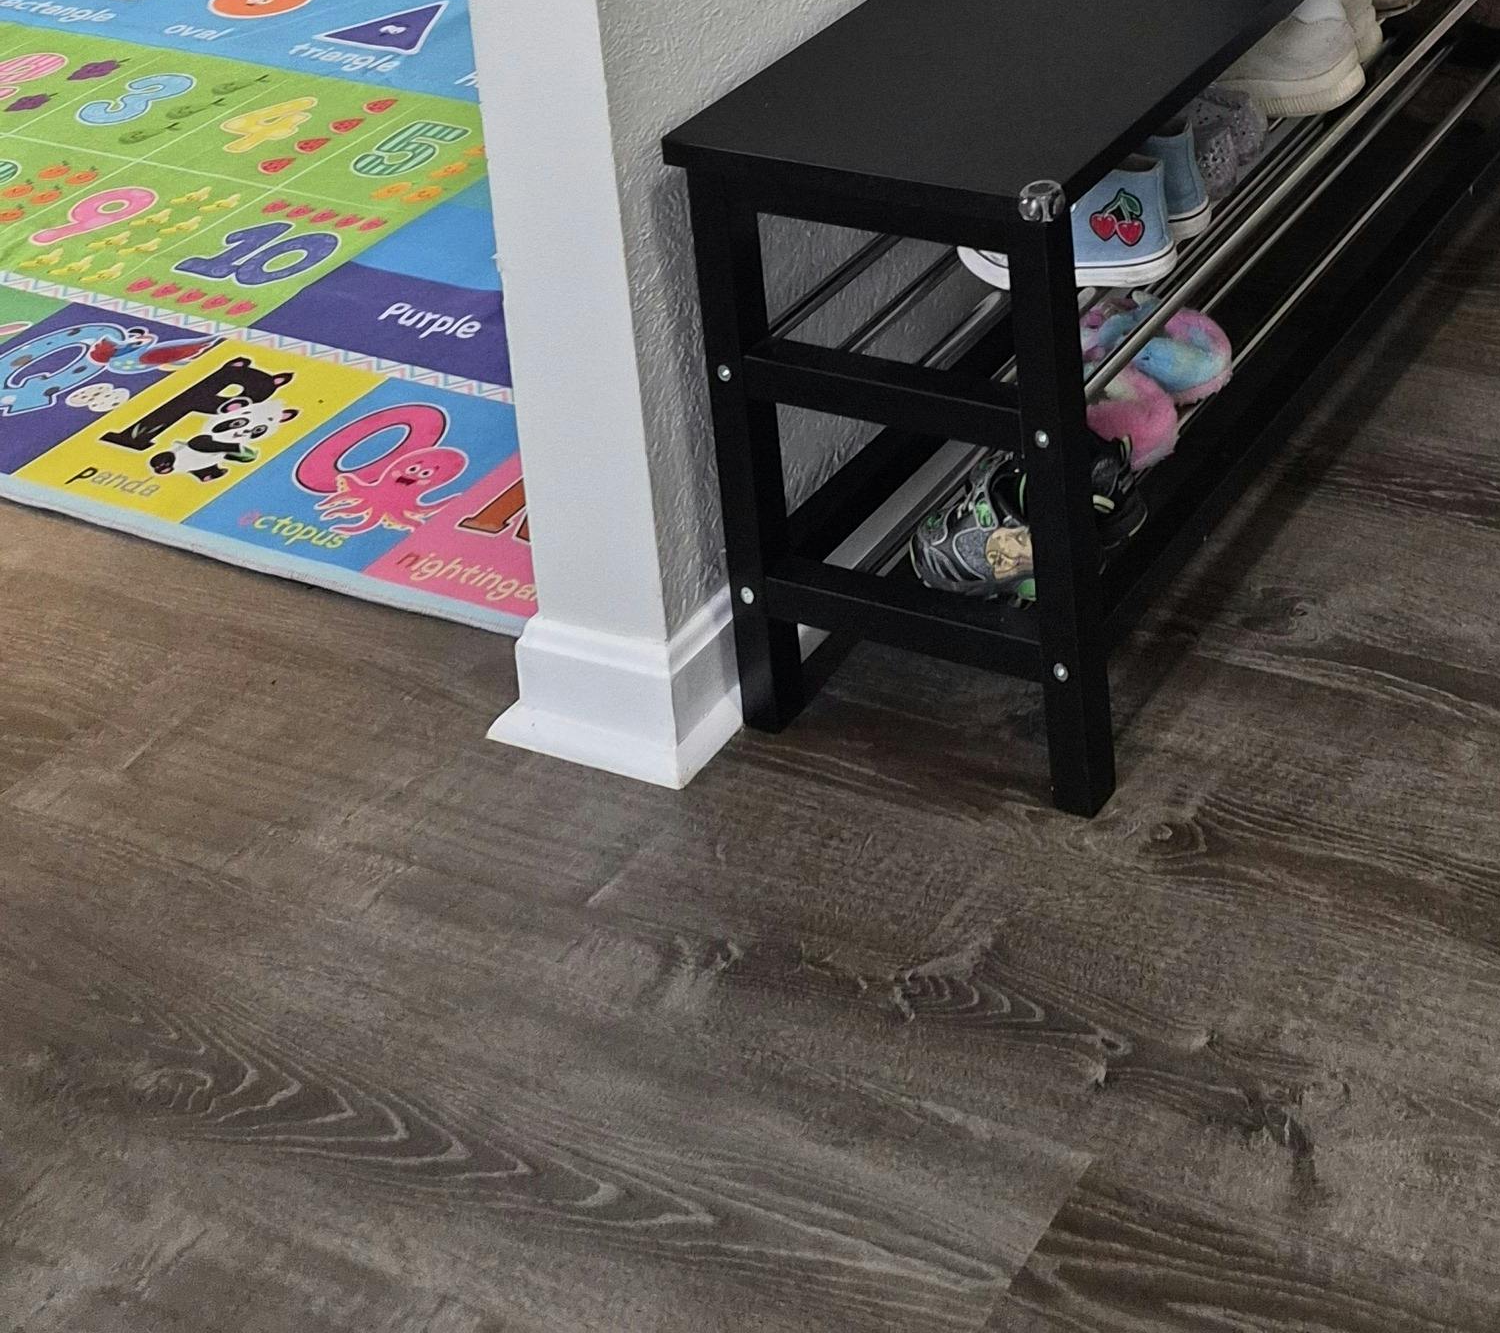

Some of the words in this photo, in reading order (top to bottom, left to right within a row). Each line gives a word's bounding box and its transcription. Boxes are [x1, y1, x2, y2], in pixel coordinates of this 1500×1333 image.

[163, 22, 231, 43] oval
[287, 43, 399, 74] triangle
[75, 72, 198, 126] 3
[220, 96, 318, 154] 4
[350, 119, 471, 178] 5
[29, 186, 160, 247] 9
[171, 220, 342, 288] 10
[379, 301, 483, 341] Purple
[65, 465, 163, 499] panda
[238, 510, 350, 550] octopus
[396, 552, 537, 602] nightinga
